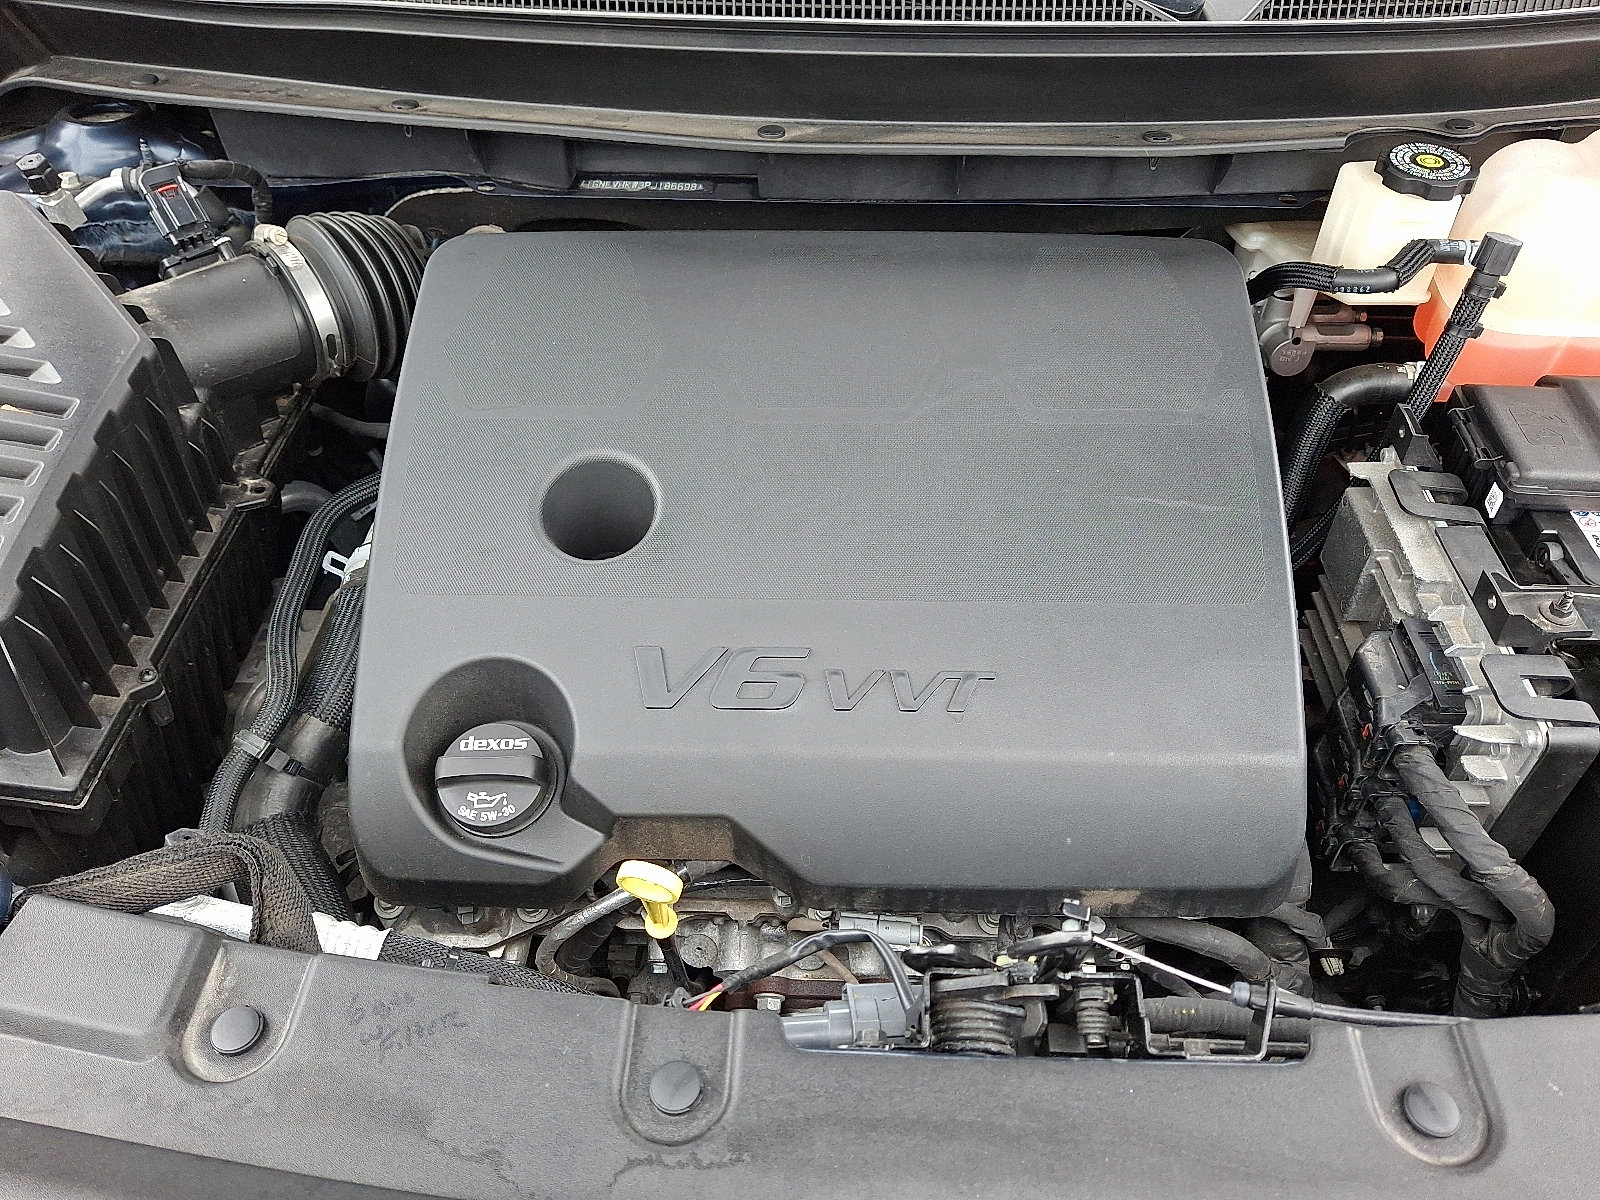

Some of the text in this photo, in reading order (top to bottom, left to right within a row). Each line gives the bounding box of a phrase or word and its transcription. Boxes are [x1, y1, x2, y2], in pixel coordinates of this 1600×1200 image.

[634, 645, 997, 713] V6 VVT
[459, 735, 531, 751] dexos
[457, 804, 516, 822] SAE 5W-30
